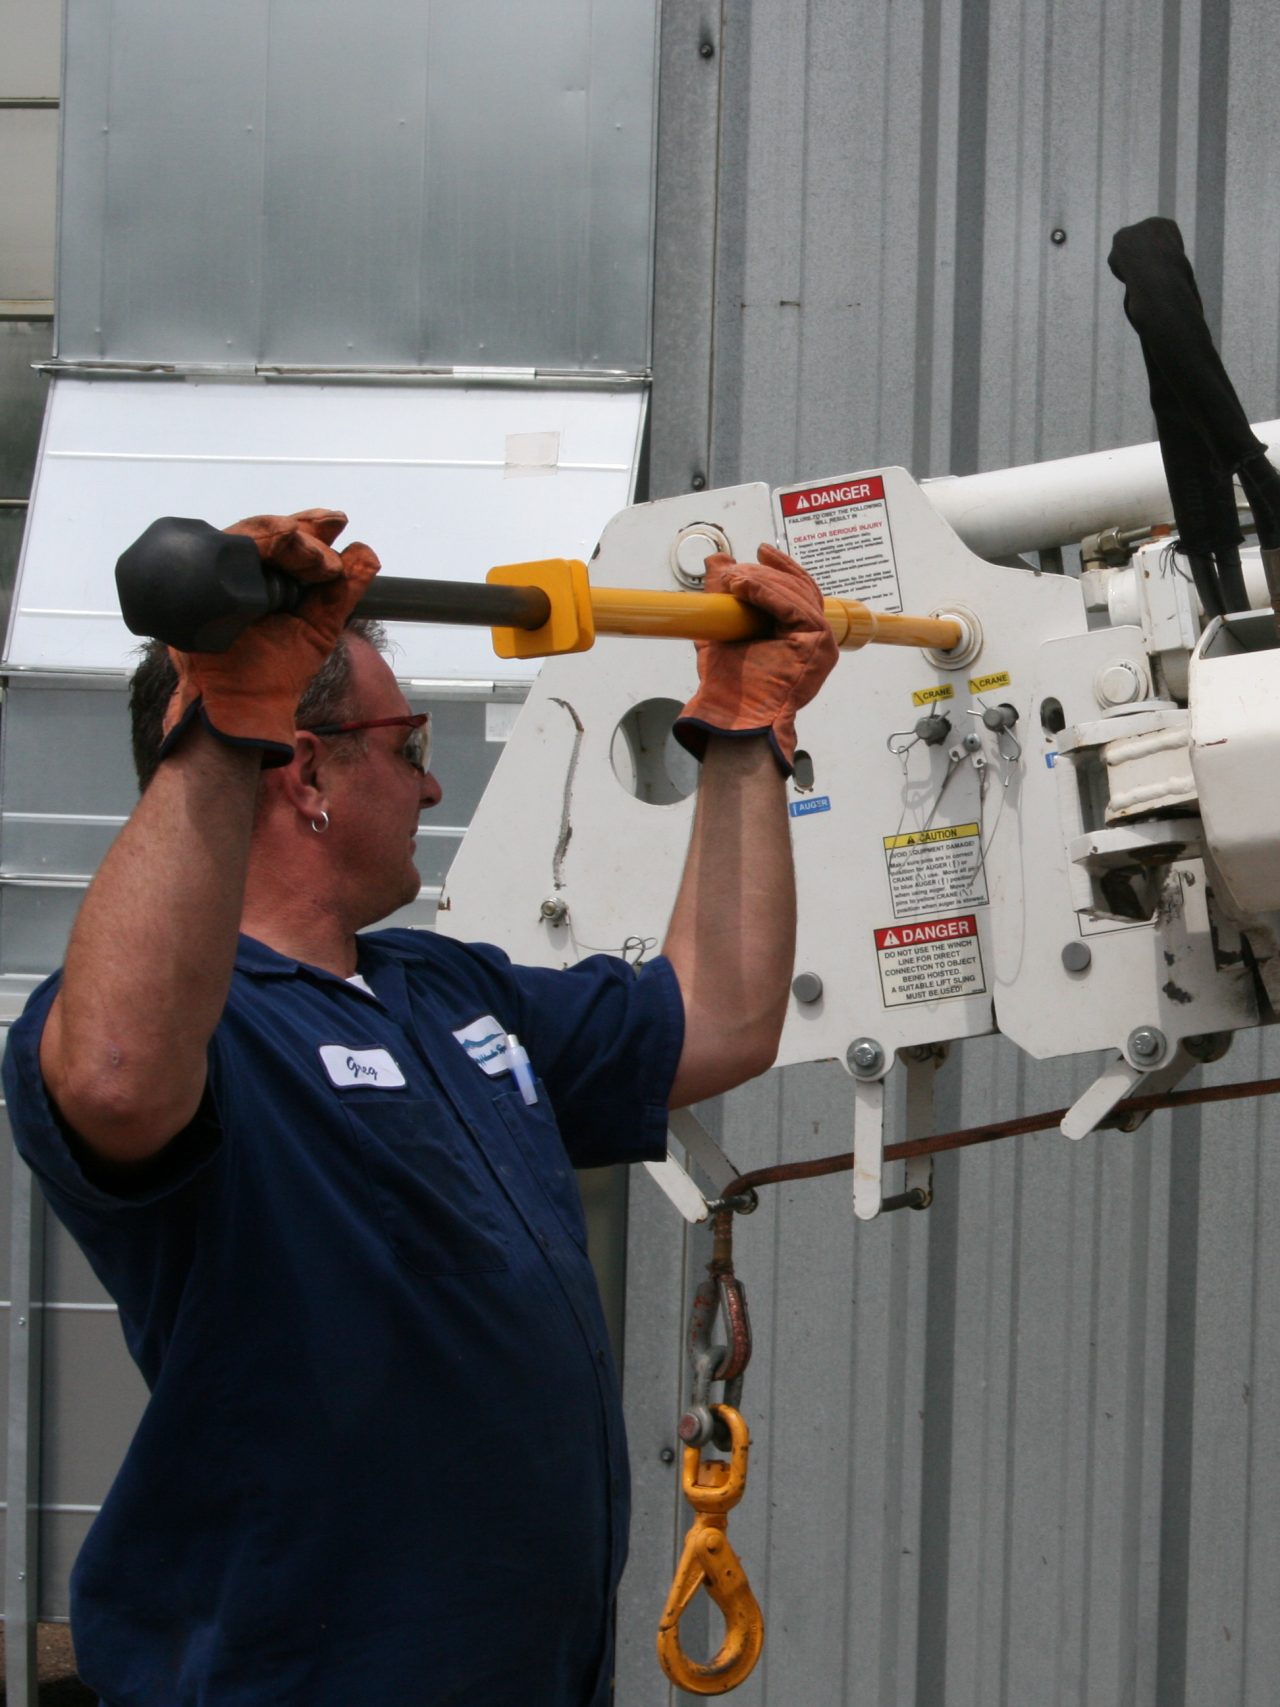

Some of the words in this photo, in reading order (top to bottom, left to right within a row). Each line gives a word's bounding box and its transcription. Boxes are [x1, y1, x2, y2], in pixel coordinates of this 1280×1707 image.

[811, 484, 870, 506] DANGER
[793, 533, 815, 543] DEATH
[829, 526, 858, 536] SERIOUS
[859, 521, 883, 531] INJURY
[979, 674, 1008, 688] CRANE
[922, 687, 951, 700] CRANE
[800, 799, 828, 811] AUGER
[919, 828, 958, 843] CAUTION
[902, 921, 969, 943] DANGER
[897, 949, 912, 957] NOT
[914, 946, 929, 954] USE
[931, 944, 945, 952] THE
[947, 940, 972, 949] WINCH
[916, 955, 931, 963] FOR
[933, 951, 961, 960] DIRECT
[885, 963, 933, 976] CONNECTION
[947, 957, 976, 967] OBJECT
[902, 974, 925, 982] BEING
[927, 968, 960, 979] HOISTED.
[898, 981, 934, 992] SUITABLE
[953, 975, 976, 984] SLING
[906, 991, 926, 1000] MUST
[940, 986, 963, 995] USED!
[346, 1056, 378, 1081] Greg
